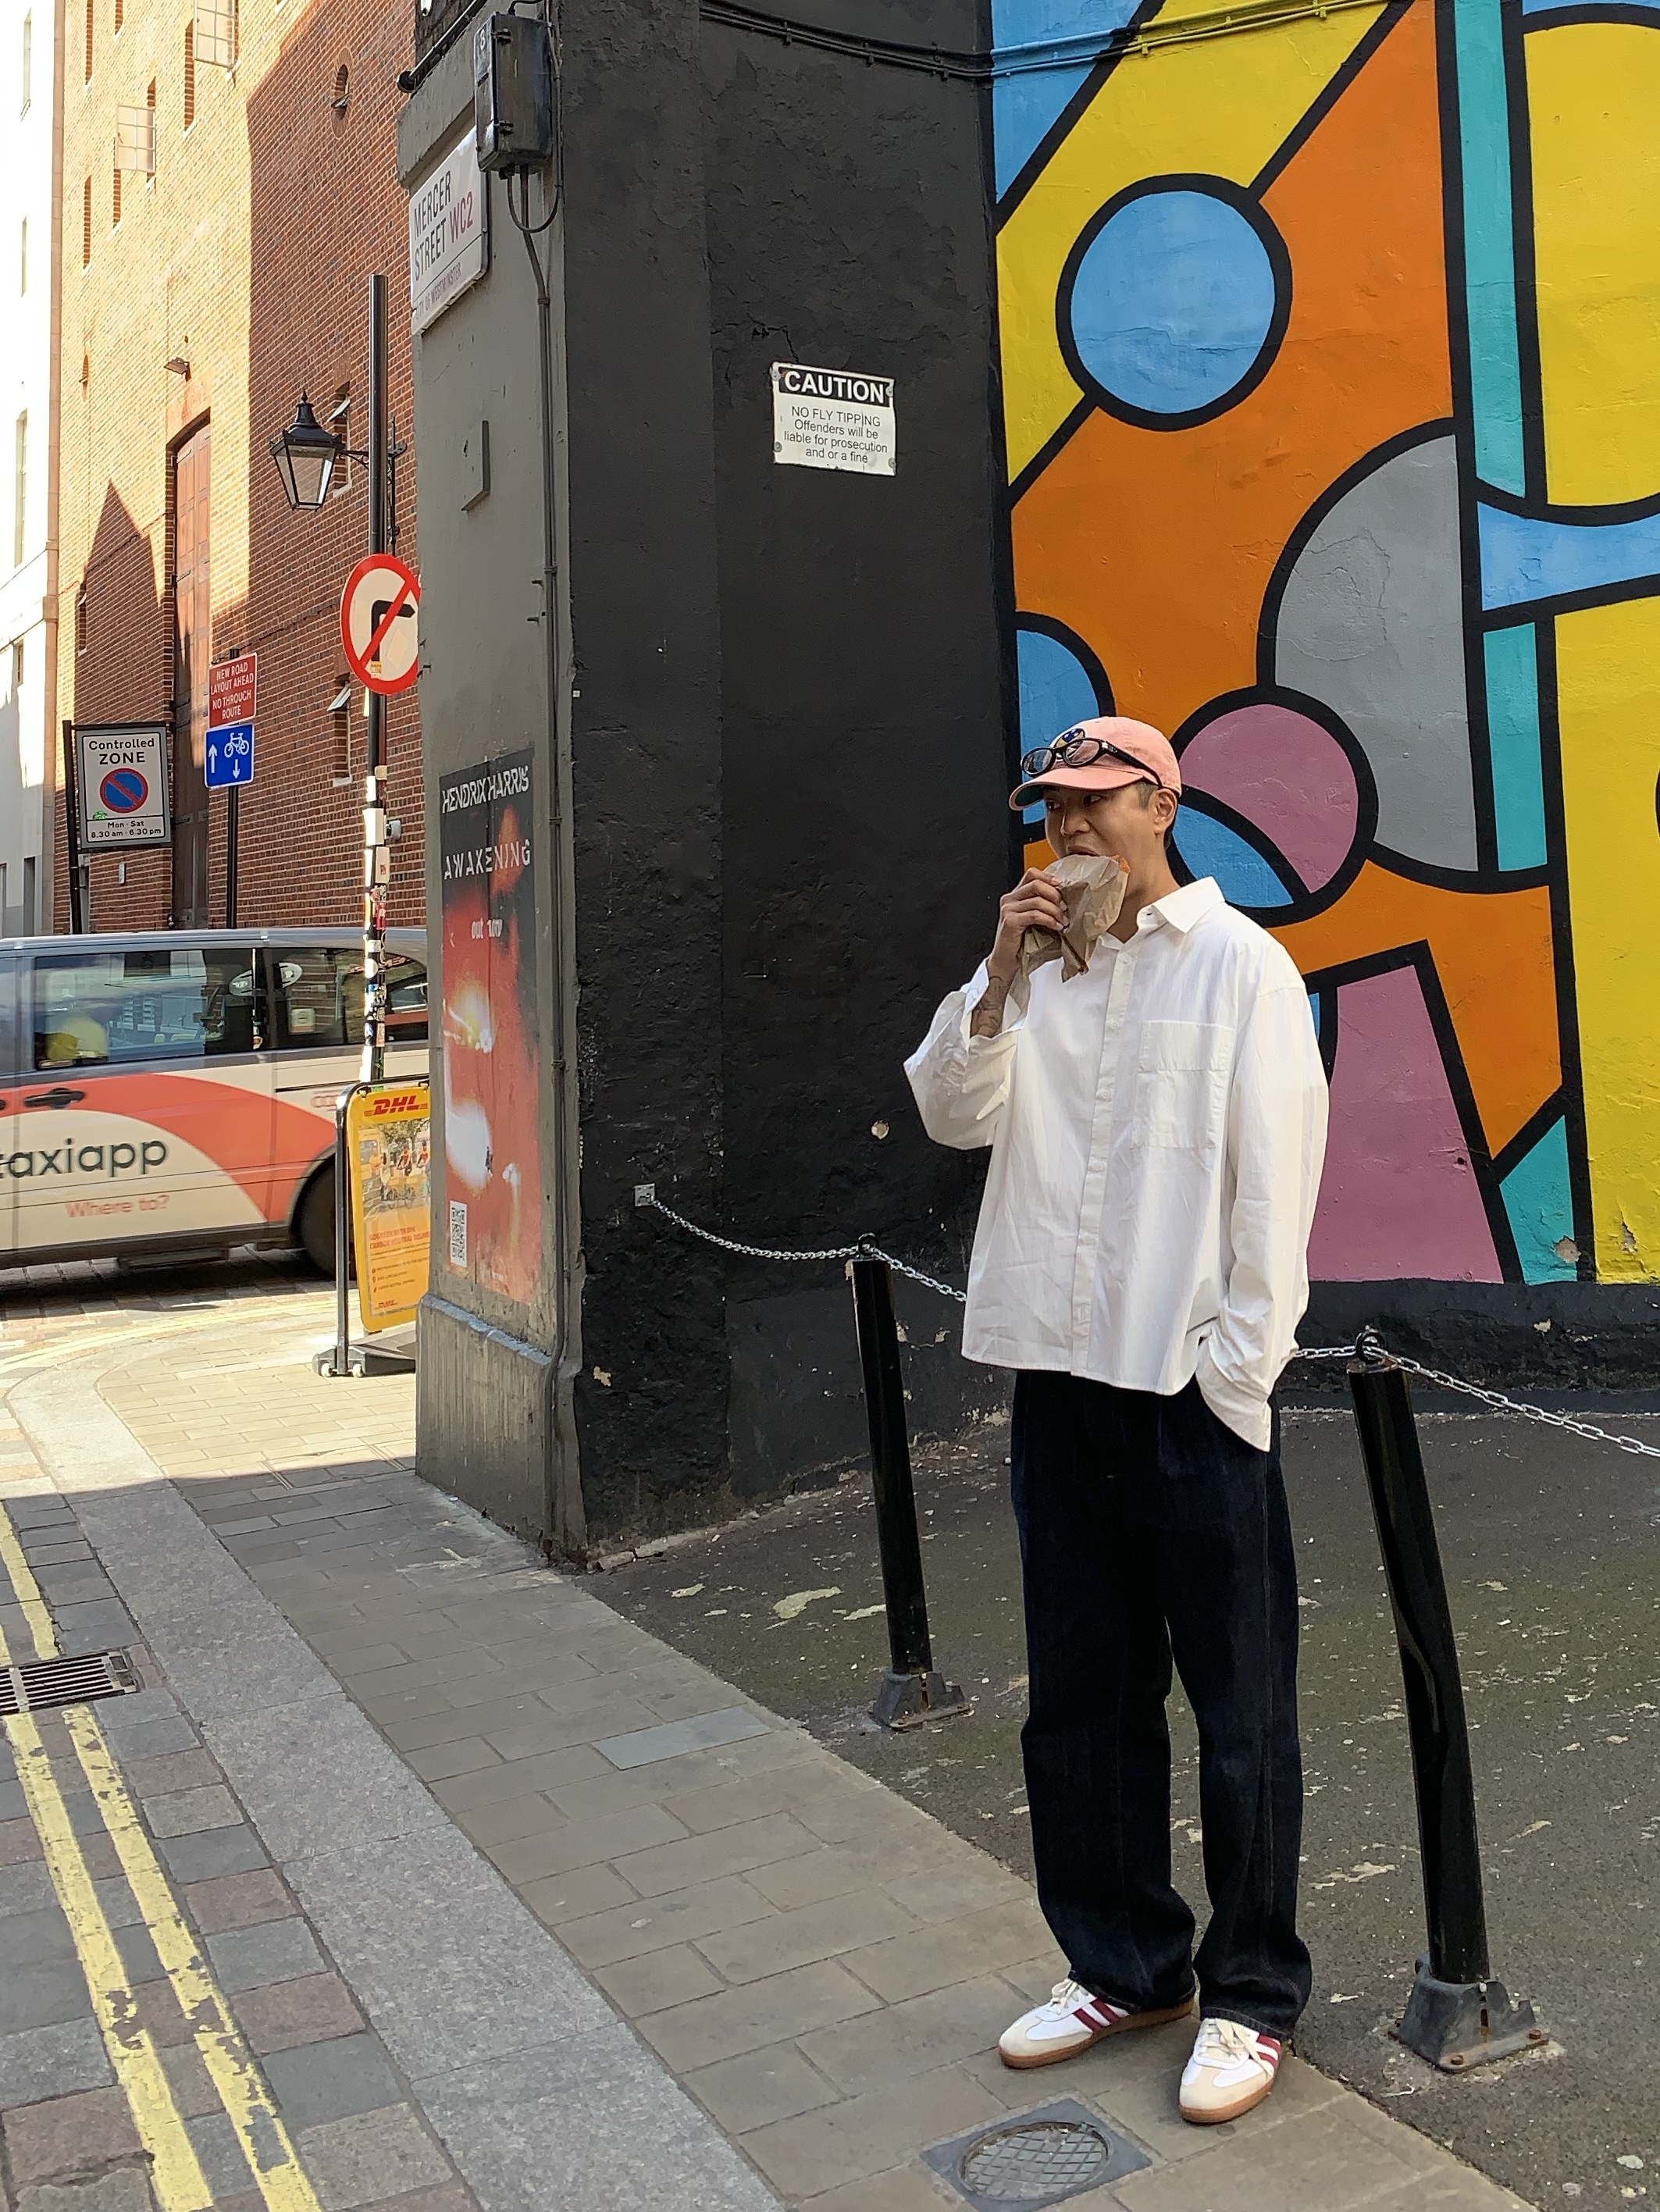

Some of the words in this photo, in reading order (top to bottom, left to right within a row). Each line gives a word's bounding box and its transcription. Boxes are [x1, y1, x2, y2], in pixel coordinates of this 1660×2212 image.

[414, 169, 451, 240] MERCER
[415, 218, 447, 281] STREET
[449, 191, 473, 244] WC2
[784, 370, 885, 404] CAUTION
[792, 406, 810, 418] NO
[812, 408, 833, 421] FLY
[836, 411, 881, 427] TIPPING
[794, 419, 845, 436] Offenders
[847, 426, 864, 437] will
[866, 428, 878, 440] be
[784, 430, 811, 443] liable
[814, 434, 828, 446] for
[831, 436, 888, 453] prosecution
[805, 447, 825, 458] and
[828, 451, 839, 459] or
[841, 452, 847, 461] a
[850, 451, 868, 463] fine
[216, 667, 230, 680] NEW
[231, 662, 248, 676] ROAD
[211, 679, 233, 695] LAYOUT
[233, 672, 254, 688] AHEAD
[212, 698, 222, 710] NO
[223, 689, 251, 707] THROUGH
[222, 705, 241, 719] ROUTE
[88, 738, 155, 750] Controlled
[99, 752, 146, 765] ZONE
[442, 778, 486, 814] HENDRIX
[487, 765, 529, 801] HARRIS
[443, 839, 531, 880] AWAKENING
[471, 917, 484, 939] out
[373, 1095, 420, 1116] DHL
[64, 1200, 134, 1218] Where
[139, 1193, 170, 1212] to?
